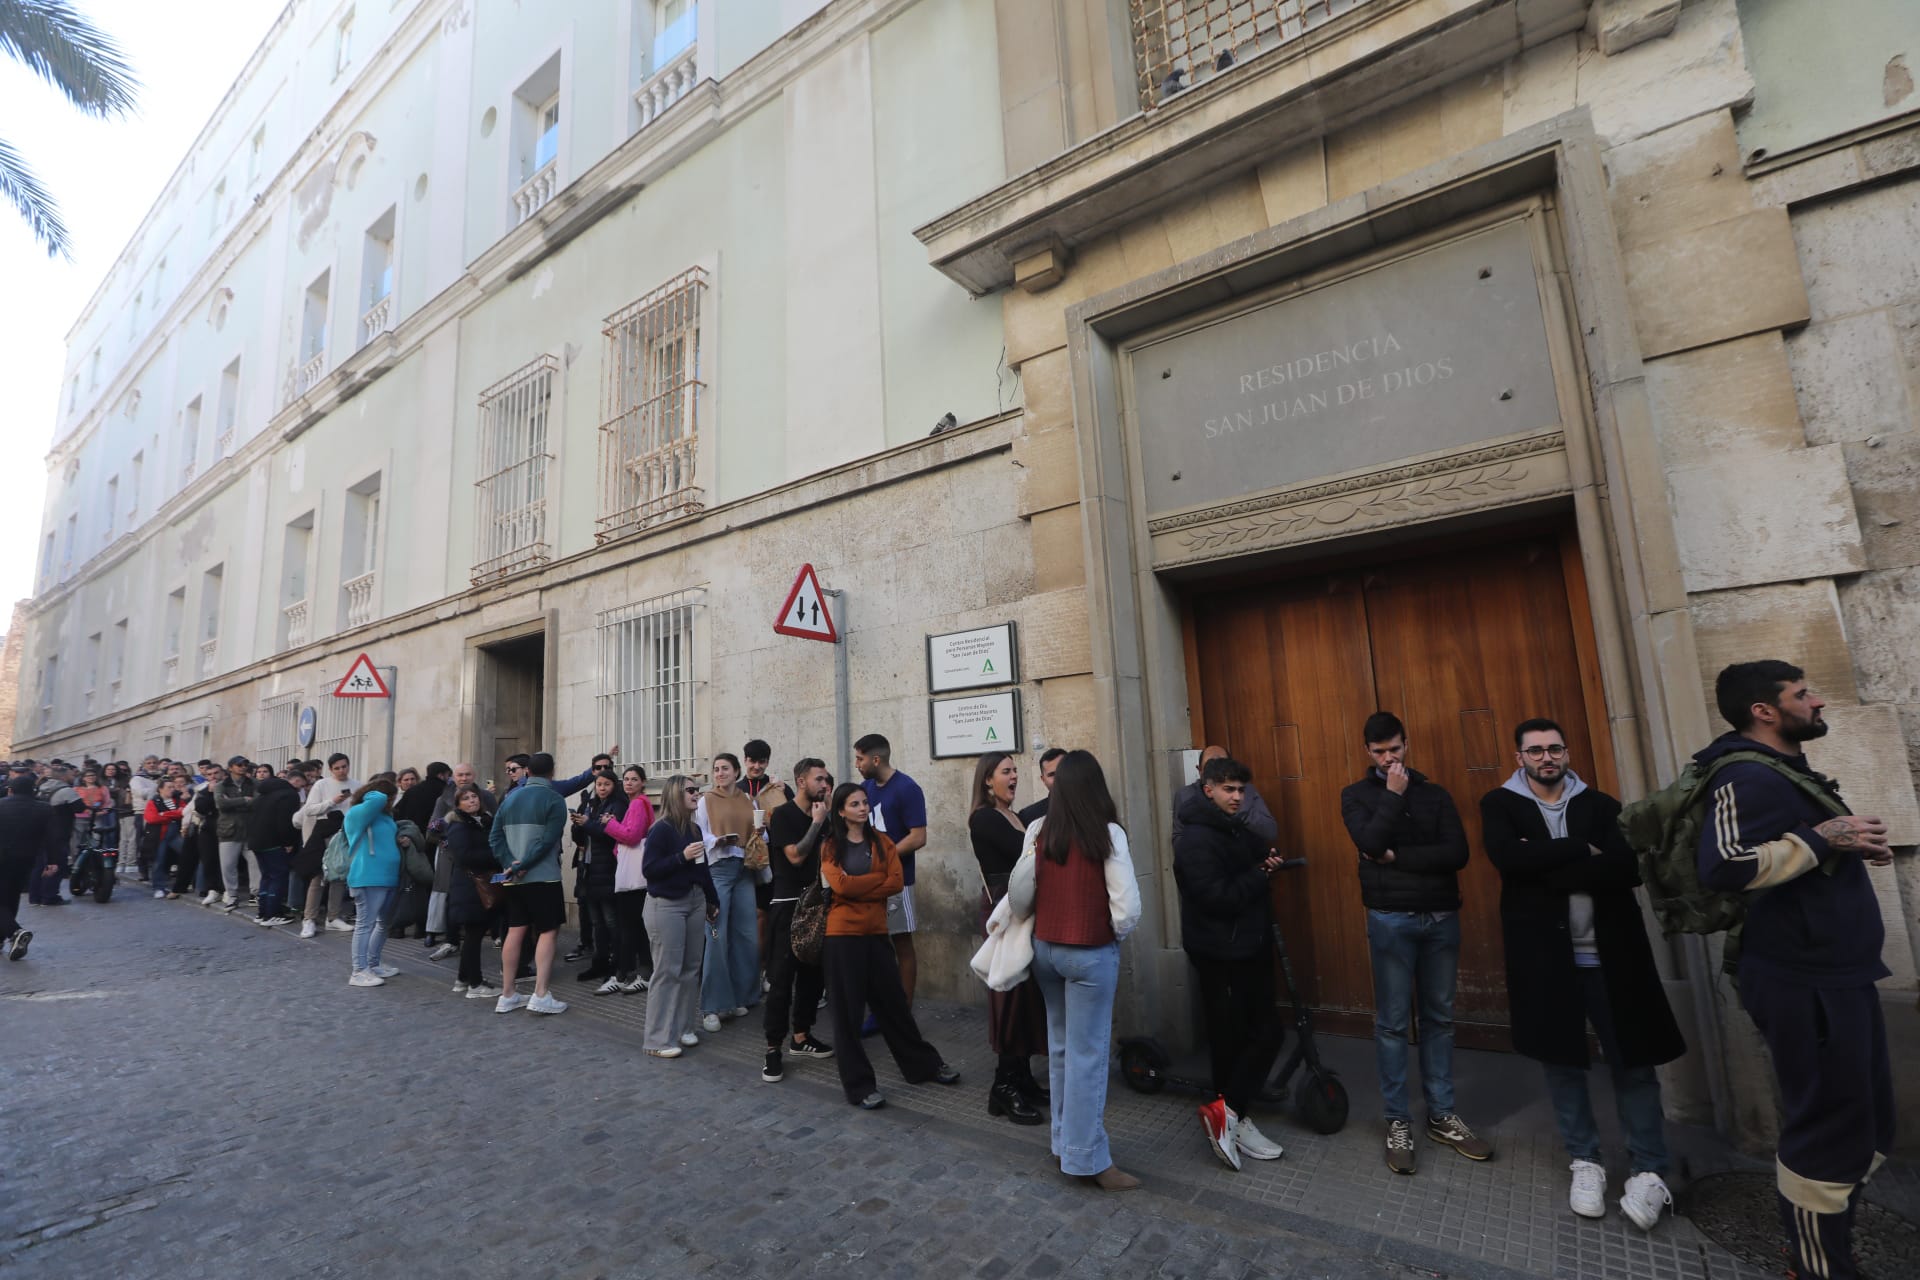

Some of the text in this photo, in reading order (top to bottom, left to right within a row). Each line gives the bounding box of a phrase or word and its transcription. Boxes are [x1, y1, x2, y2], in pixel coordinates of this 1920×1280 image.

[1239, 332, 1401, 394] RESIDENCIA
[1204, 357, 1454, 439] SAN JUAN DE DIOS
[949, 636, 990, 647] Centro Residencial
[956, 643, 976, 651] Personas
[977, 641, 994, 649] Mayores
[959, 710, 979, 718] Personas
